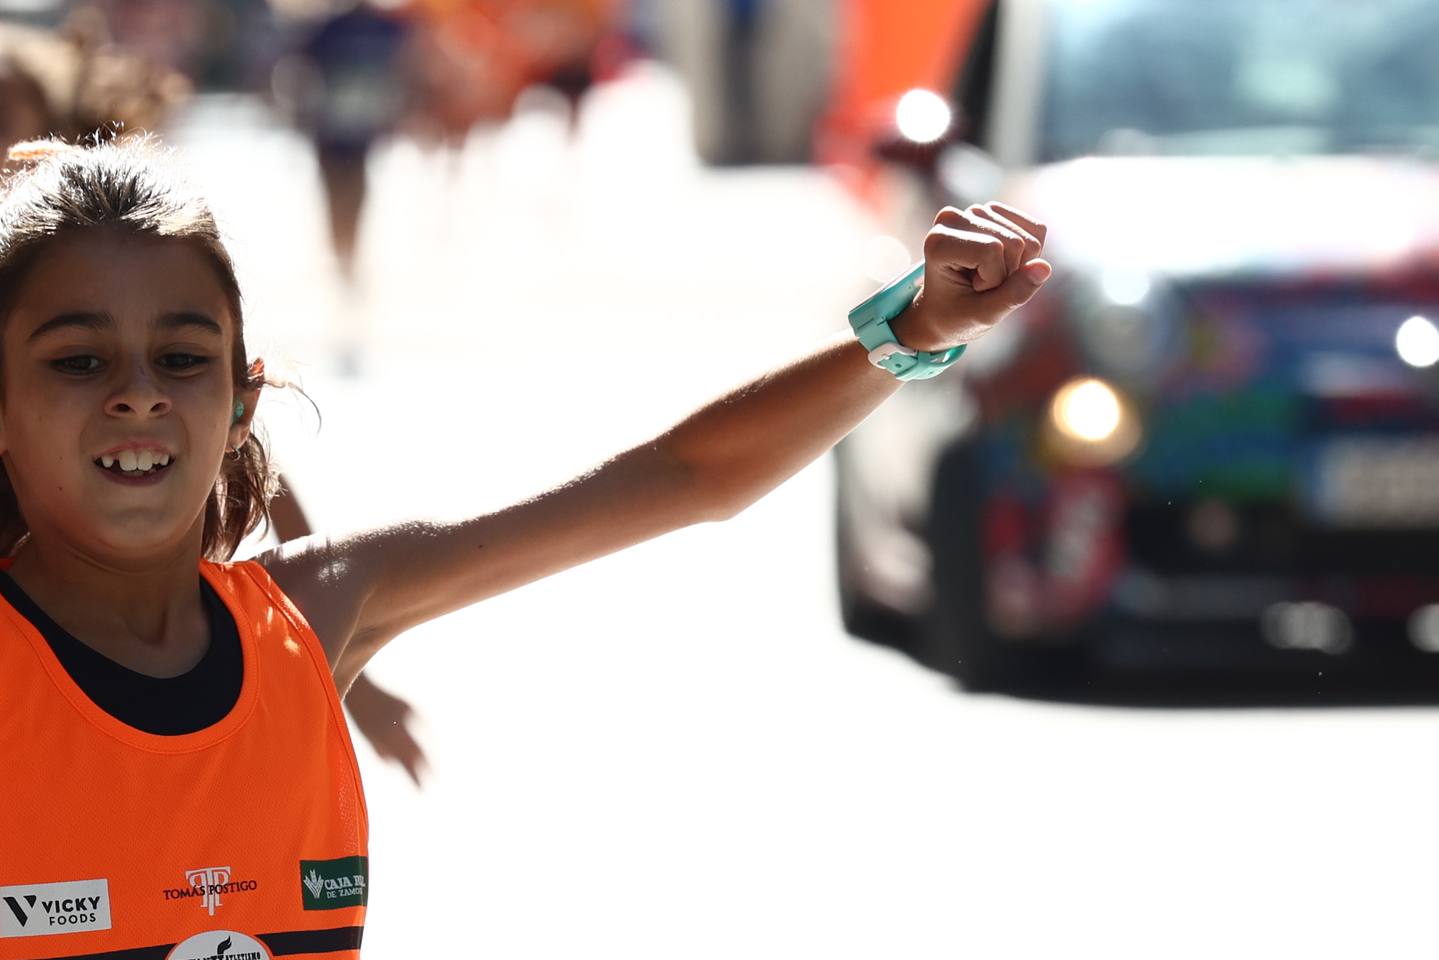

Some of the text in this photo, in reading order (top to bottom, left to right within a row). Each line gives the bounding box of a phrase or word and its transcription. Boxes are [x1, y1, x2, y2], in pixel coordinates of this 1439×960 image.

[324, 876, 353, 890] CAJA
[163, 880, 258, 901] TOMÁS POSTIGO
[326, 890, 337, 899] DE
[42, 896, 101, 914] VICKY
[49, 912, 97, 926] FOODS
